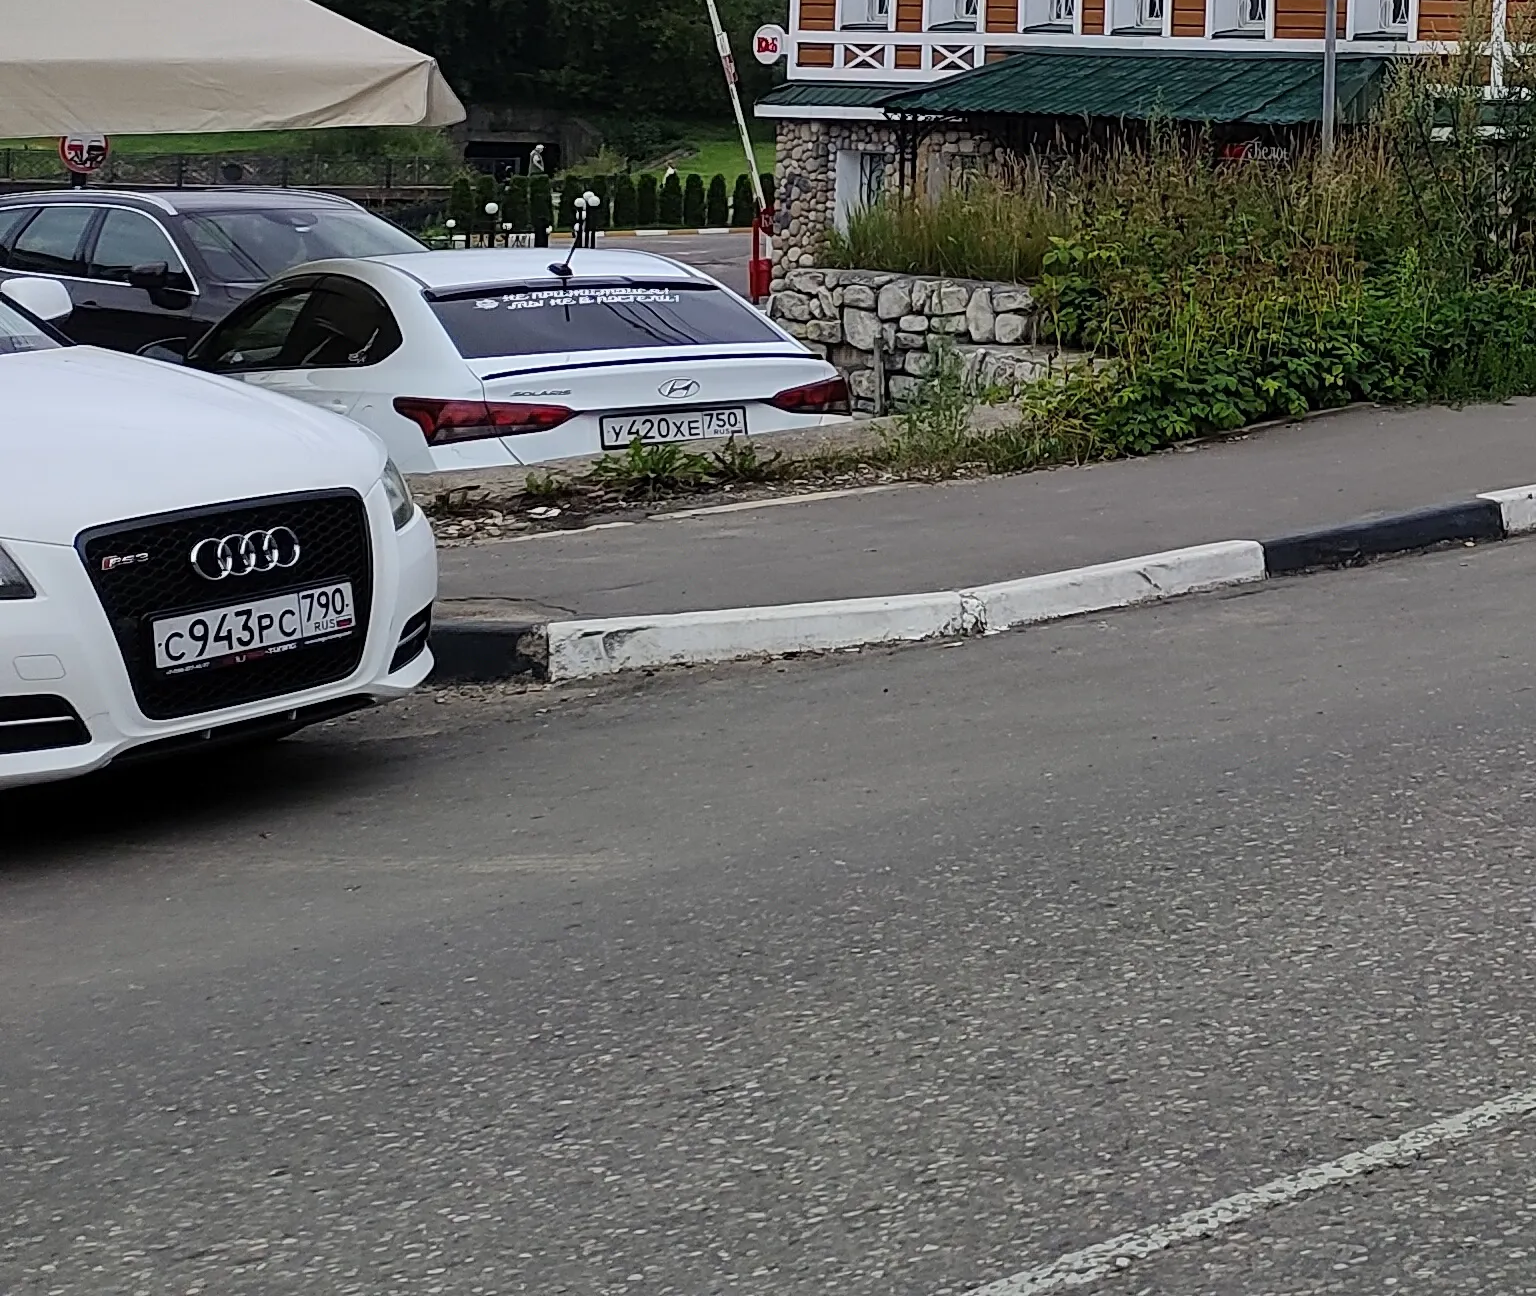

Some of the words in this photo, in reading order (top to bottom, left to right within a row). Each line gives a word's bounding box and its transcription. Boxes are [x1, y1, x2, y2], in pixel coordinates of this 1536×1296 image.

[611, 417, 700, 442] У420ХЕ
[704, 411, 738, 430] 750
[164, 608, 298, 661] С943РС
[301, 587, 346, 622] 790
[314, 618, 336, 632] RUS
